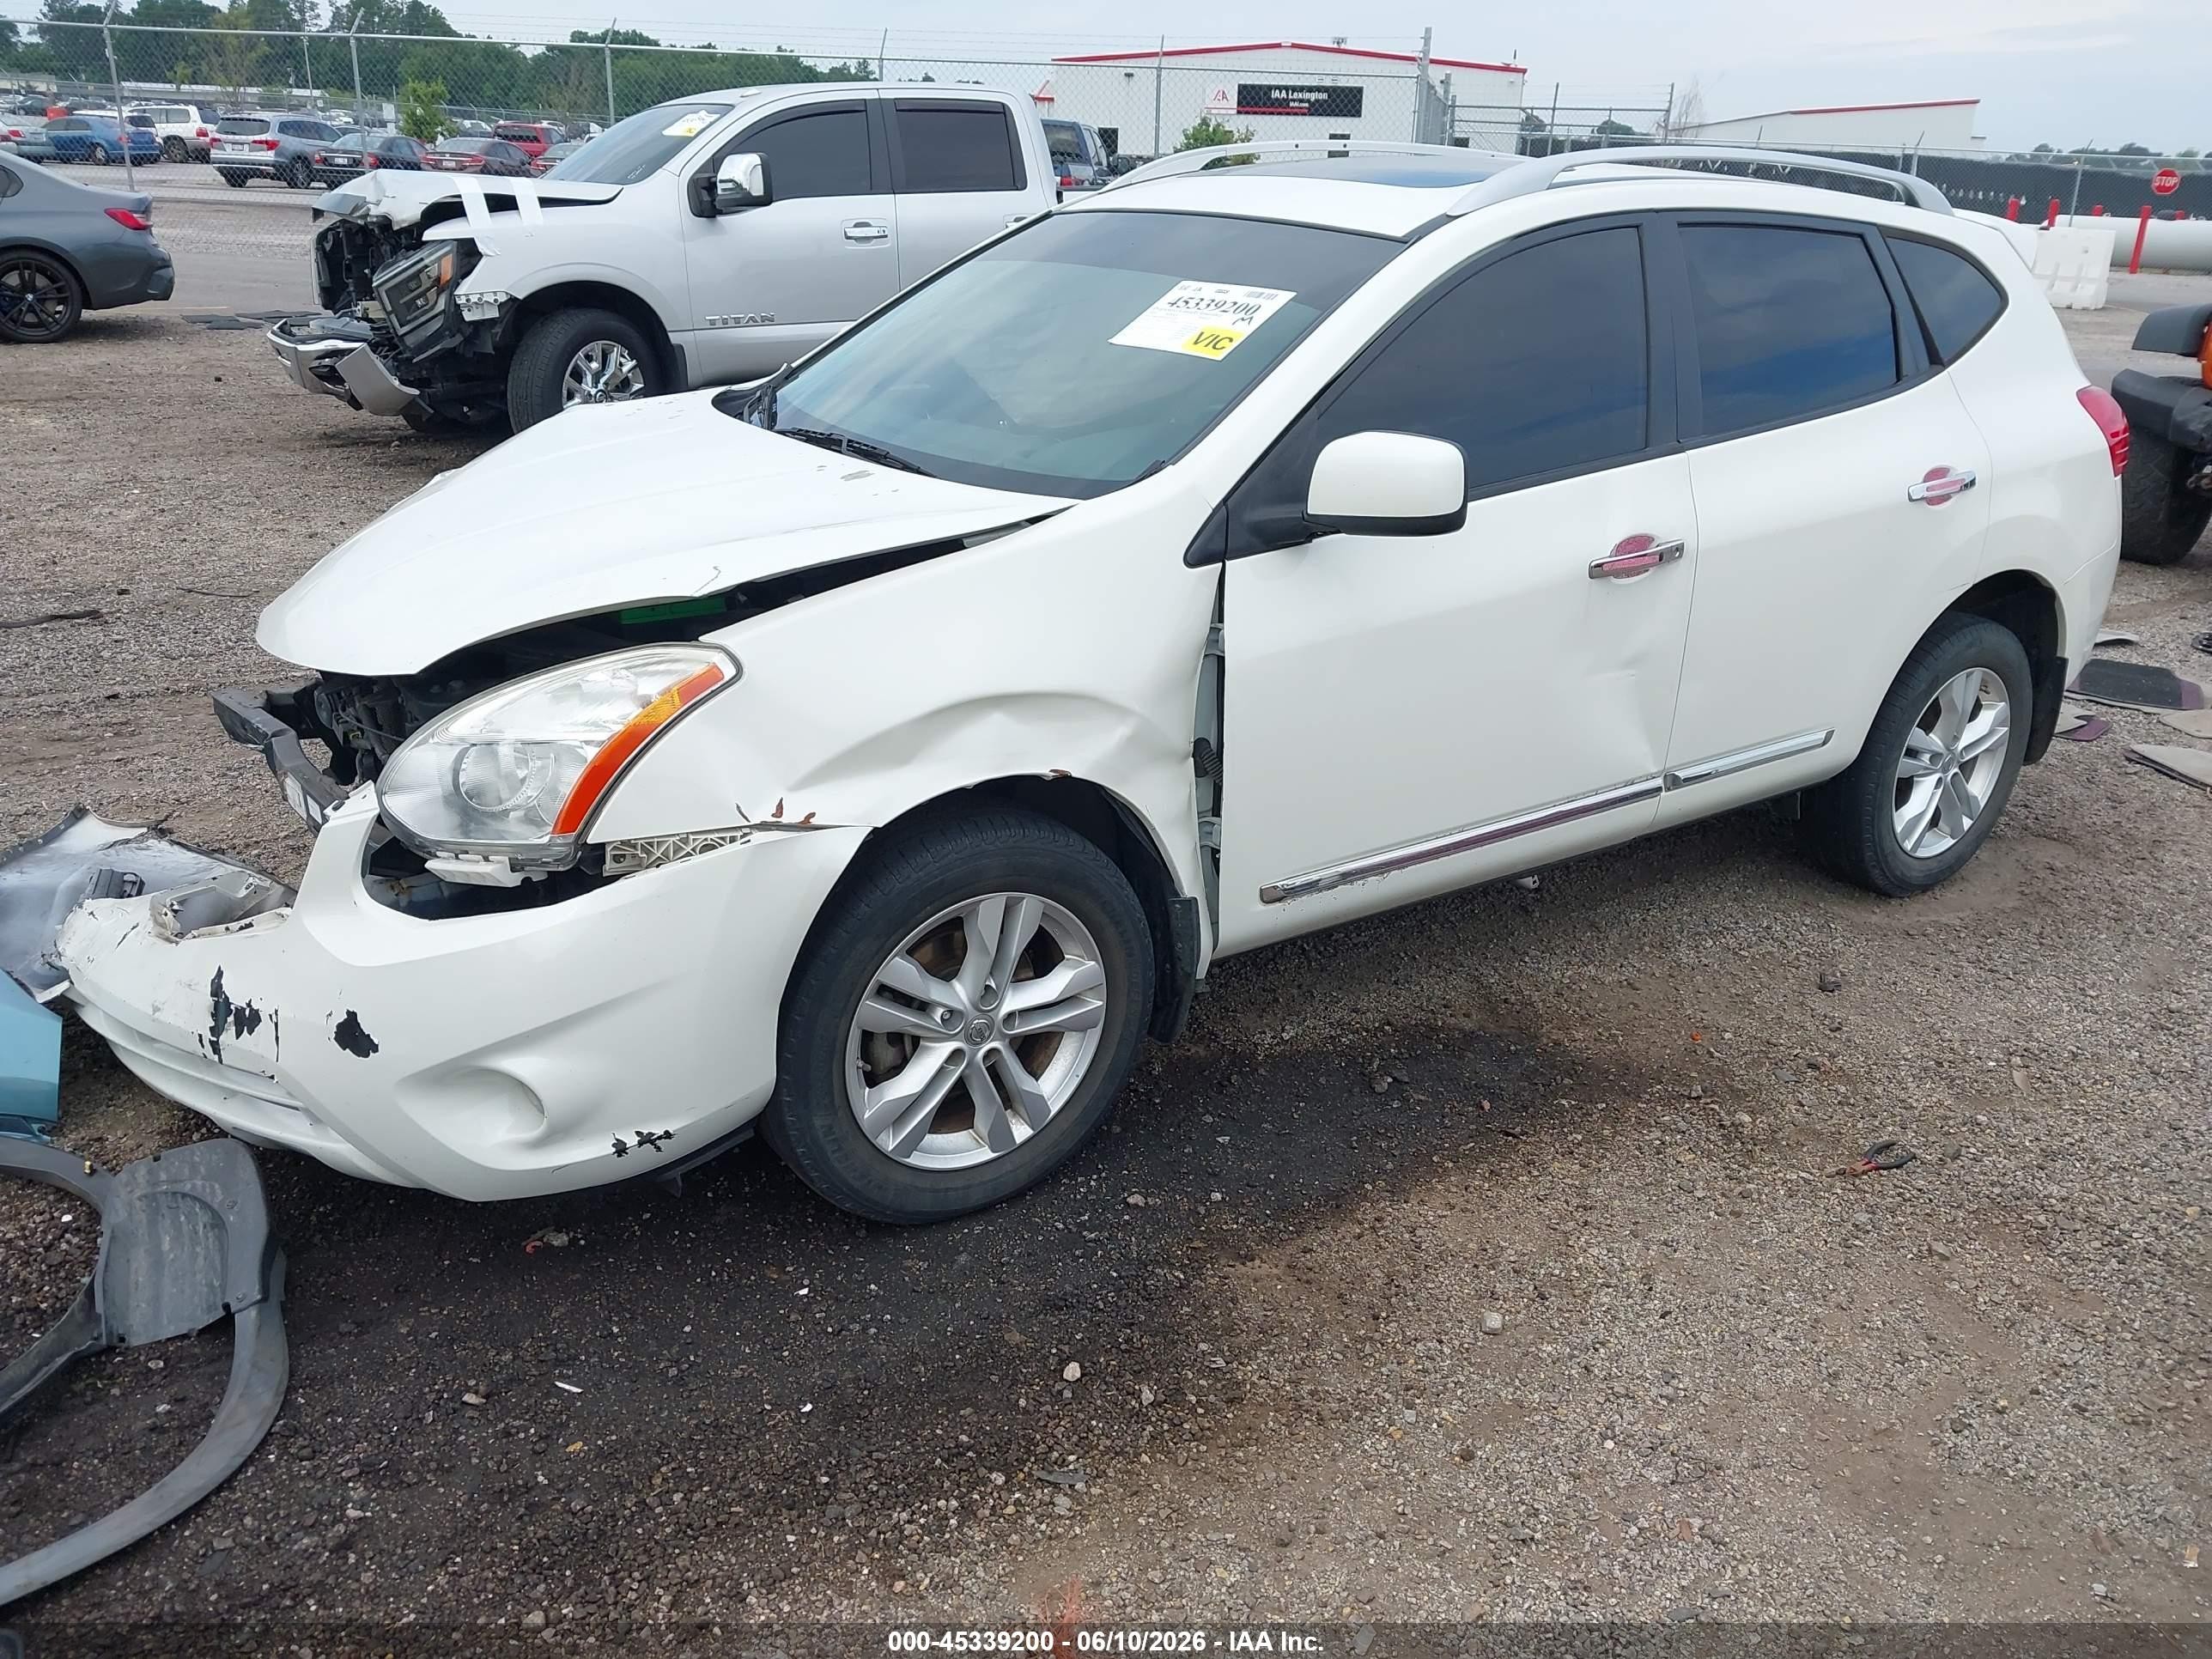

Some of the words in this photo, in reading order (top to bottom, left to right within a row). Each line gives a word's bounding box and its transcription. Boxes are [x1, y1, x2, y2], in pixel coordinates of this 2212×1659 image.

[1271, 88, 1287, 99] IAA
[1289, 89, 1328, 101] Lexington
[2154, 176, 2179, 186] STOP
[1167, 296, 1261, 316] 45339200
[705, 312, 775, 326] TITAN
[1192, 331, 1234, 350] VIC
